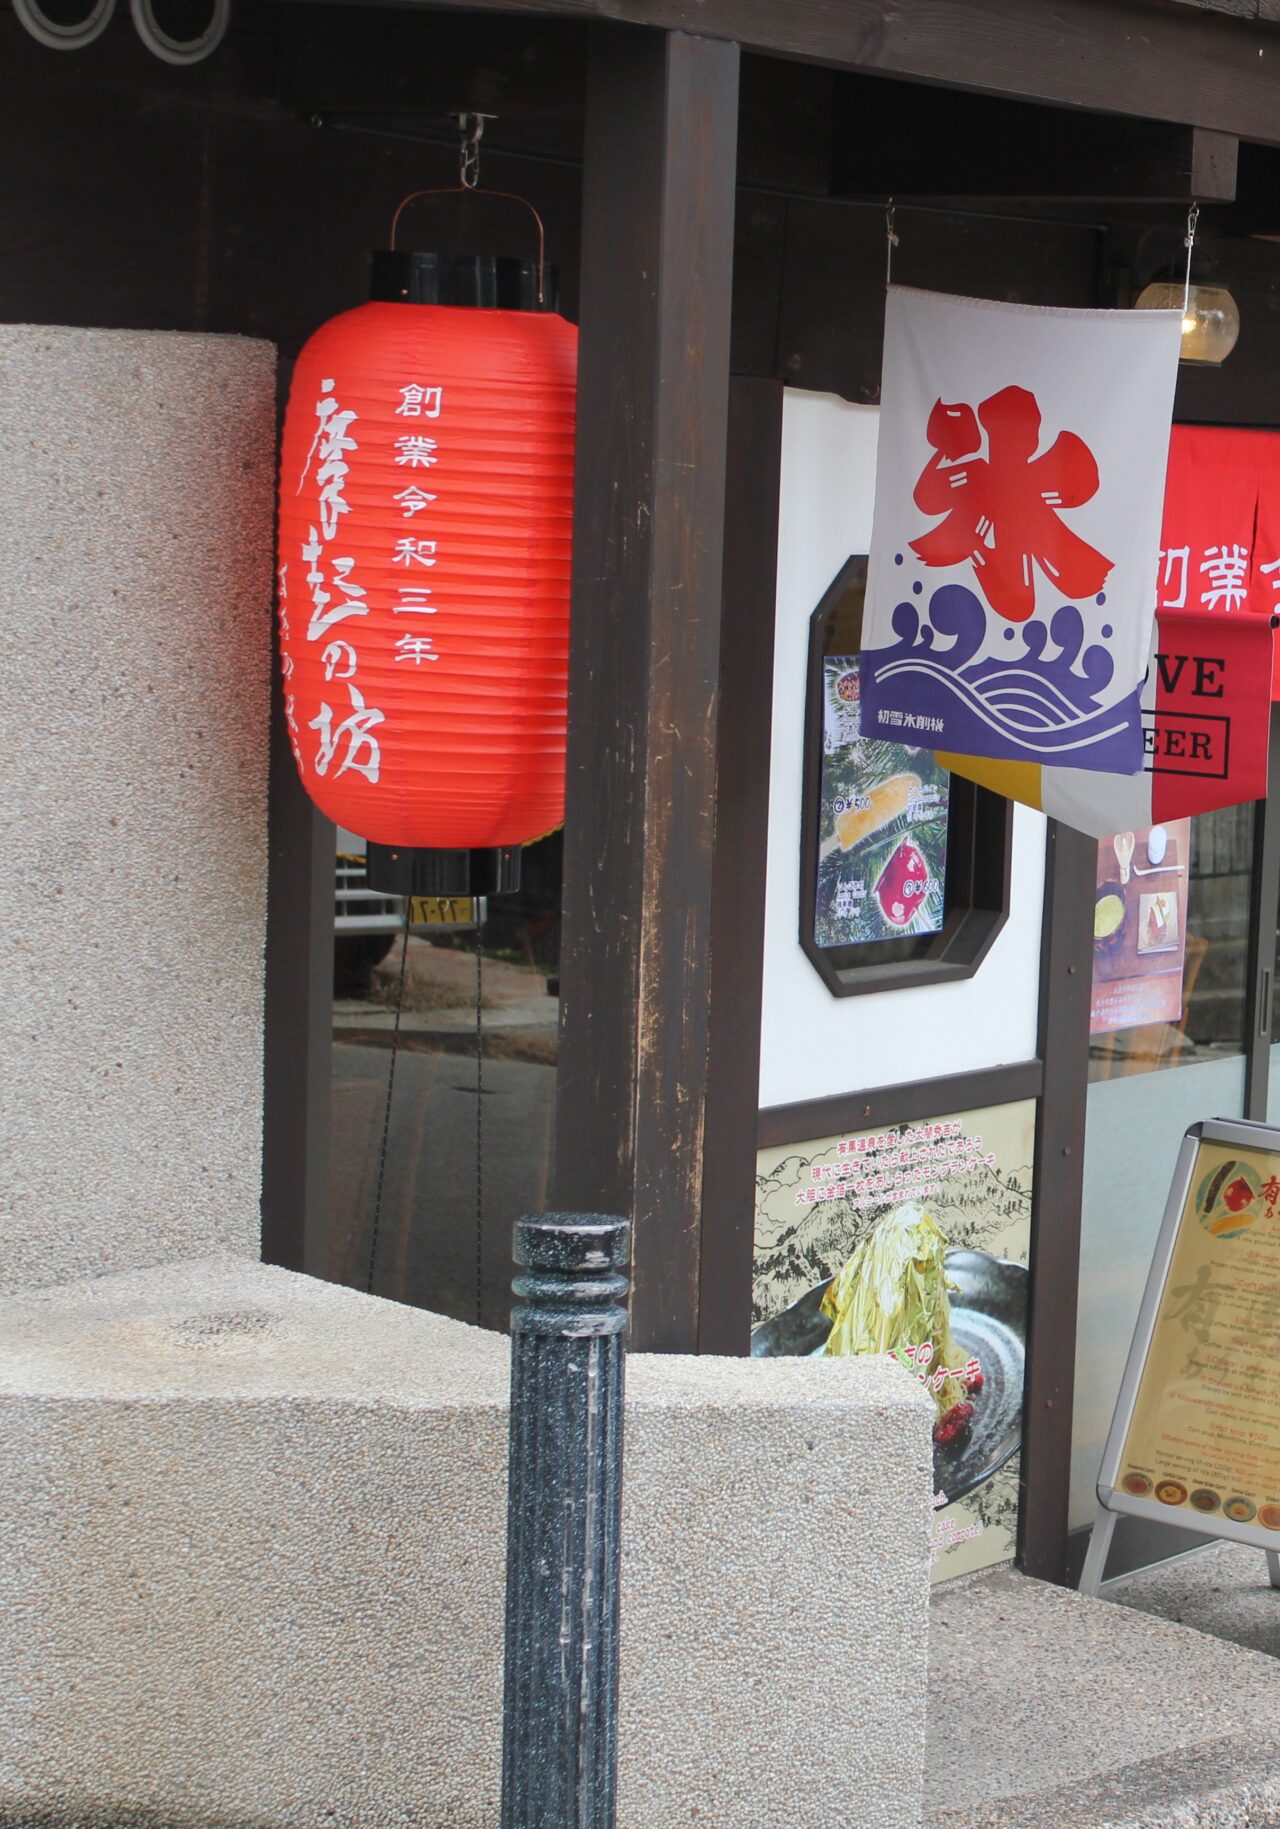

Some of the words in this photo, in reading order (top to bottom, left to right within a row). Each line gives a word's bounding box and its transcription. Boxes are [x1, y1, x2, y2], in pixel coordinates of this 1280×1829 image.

[391, 383, 443, 666] 創業令和三年
[908, 385, 1116, 621] 氷
[1146, 654, 1226, 698] VE
